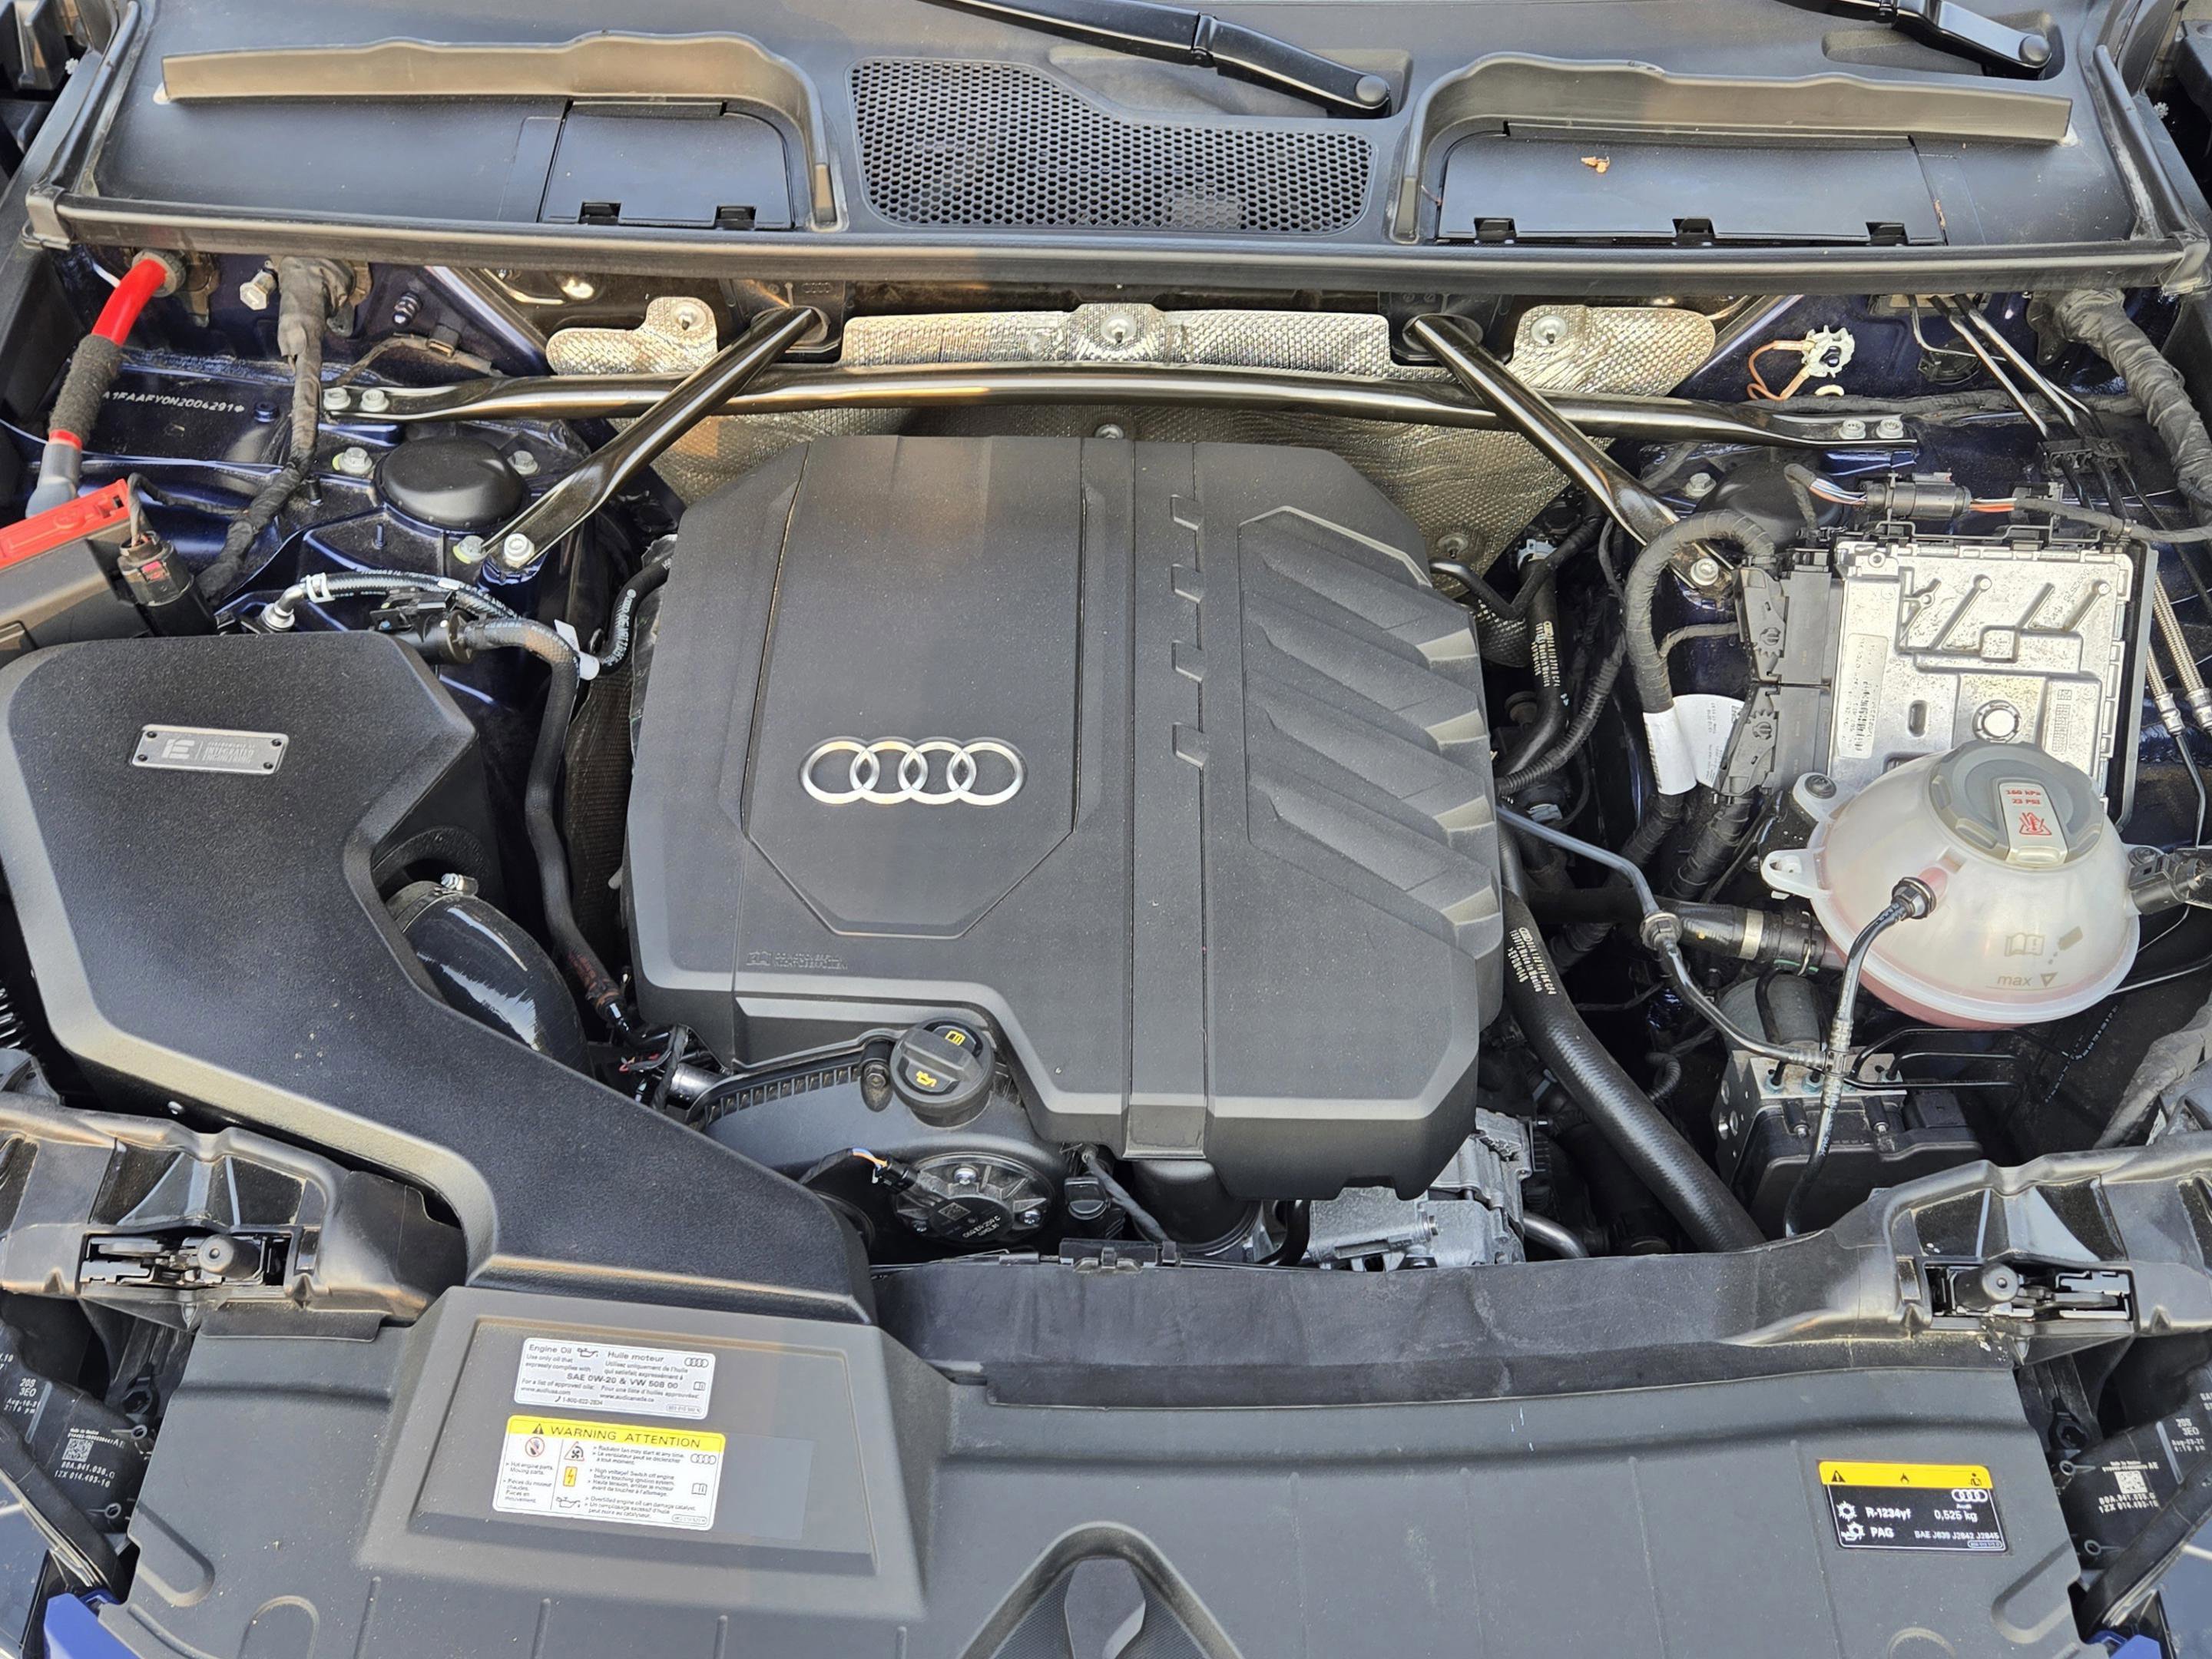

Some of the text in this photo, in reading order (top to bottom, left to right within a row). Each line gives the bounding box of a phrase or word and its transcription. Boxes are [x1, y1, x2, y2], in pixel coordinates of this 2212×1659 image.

[1998, 975, 2032, 986] max
[528, 1344, 558, 1353] Engine
[631, 1353, 664, 1363] moteur
[566, 1373, 585, 1381] SAE
[588, 1375, 617, 1383] 0W-20
[551, 1426, 617, 1440] WARNING
[624, 1433, 700, 1448] ATTENTION
[1865, 1507, 1979, 1523] R-1234yf 0,525 kg
[1869, 1527, 1894, 1538] PAG
